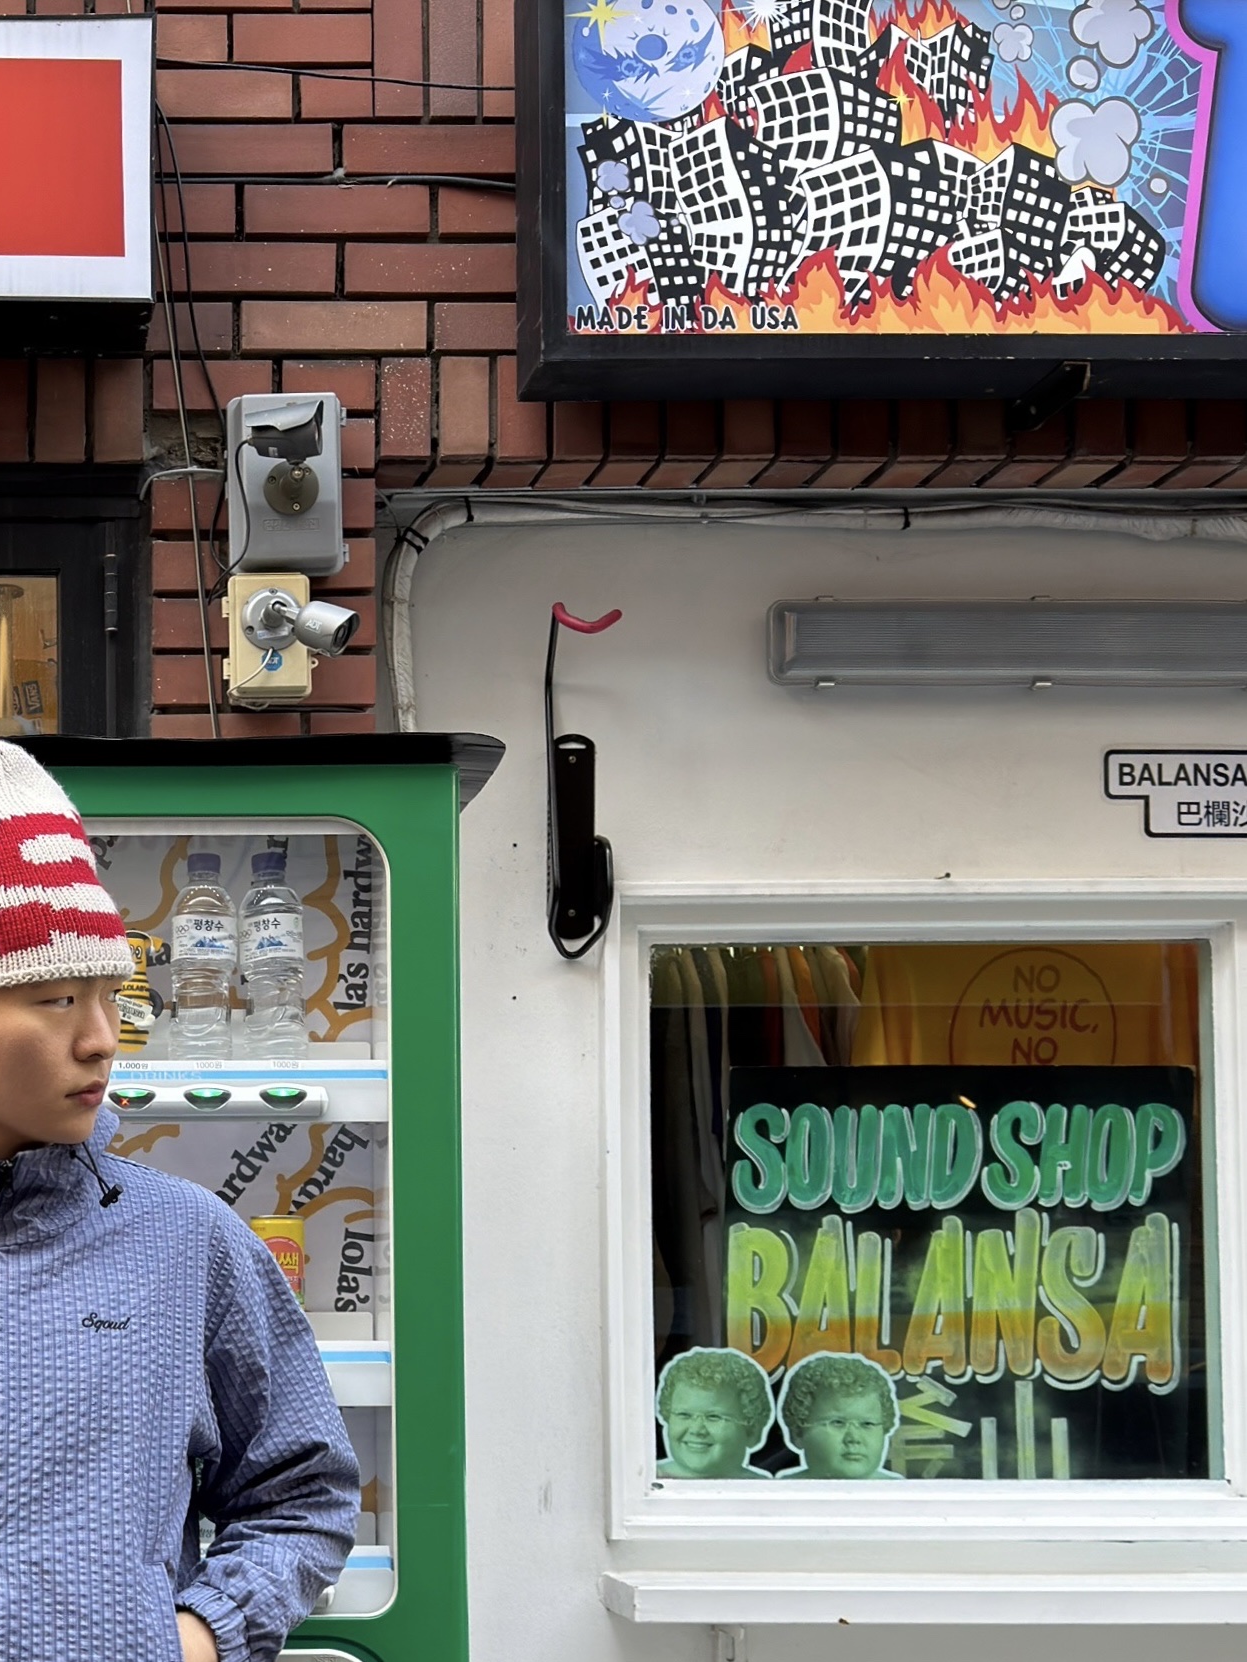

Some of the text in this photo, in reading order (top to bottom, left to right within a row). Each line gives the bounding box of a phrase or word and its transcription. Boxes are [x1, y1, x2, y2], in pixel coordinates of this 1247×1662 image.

[576, 303, 800, 332] MADE IN DA USA
[1118, 762, 1247, 787] BALANSA
[193, 918, 224, 932] 평창수
[253, 918, 281, 932] 평창수
[1013, 963, 1061, 993] NO
[979, 1000, 1100, 1036] MUSIC,
[1010, 1037, 1059, 1066] NO
[733, 1100, 1187, 1214] SOUND SHOP
[726, 1208, 1180, 1396] BALANSA
